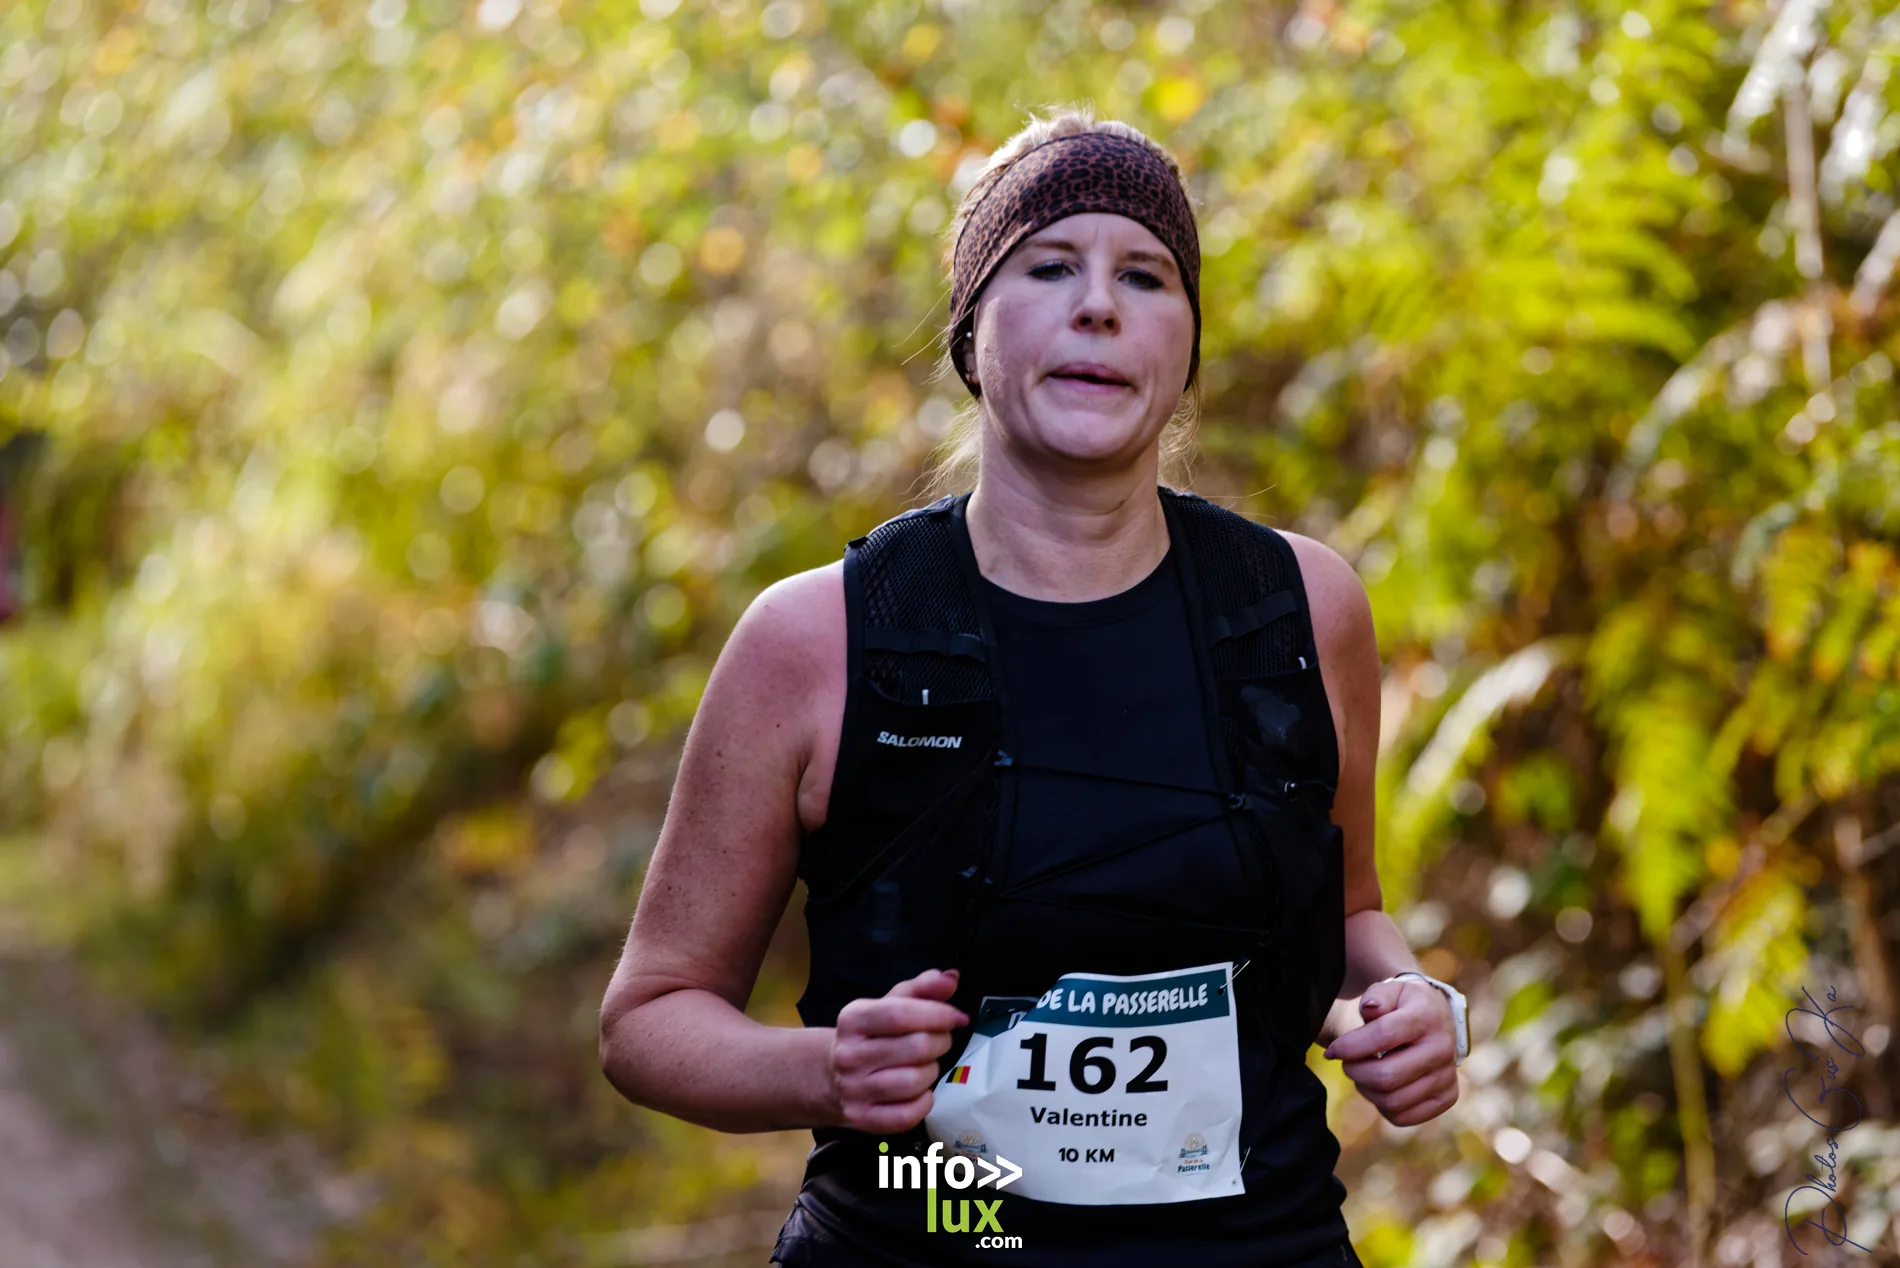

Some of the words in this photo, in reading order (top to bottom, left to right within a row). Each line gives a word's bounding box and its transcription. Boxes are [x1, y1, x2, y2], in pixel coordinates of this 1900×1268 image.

[877, 731, 962, 748] SALOMON
[1036, 988, 1064, 1010] DE
[1068, 990, 1096, 1014] LA
[1102, 983, 1208, 1015] PASSERELLE
[1016, 1032, 1169, 1094] 162
[1030, 1107, 1148, 1127] Valentine
[1058, 1147, 1079, 1163] 10
[1086, 1148, 1115, 1163] KM
